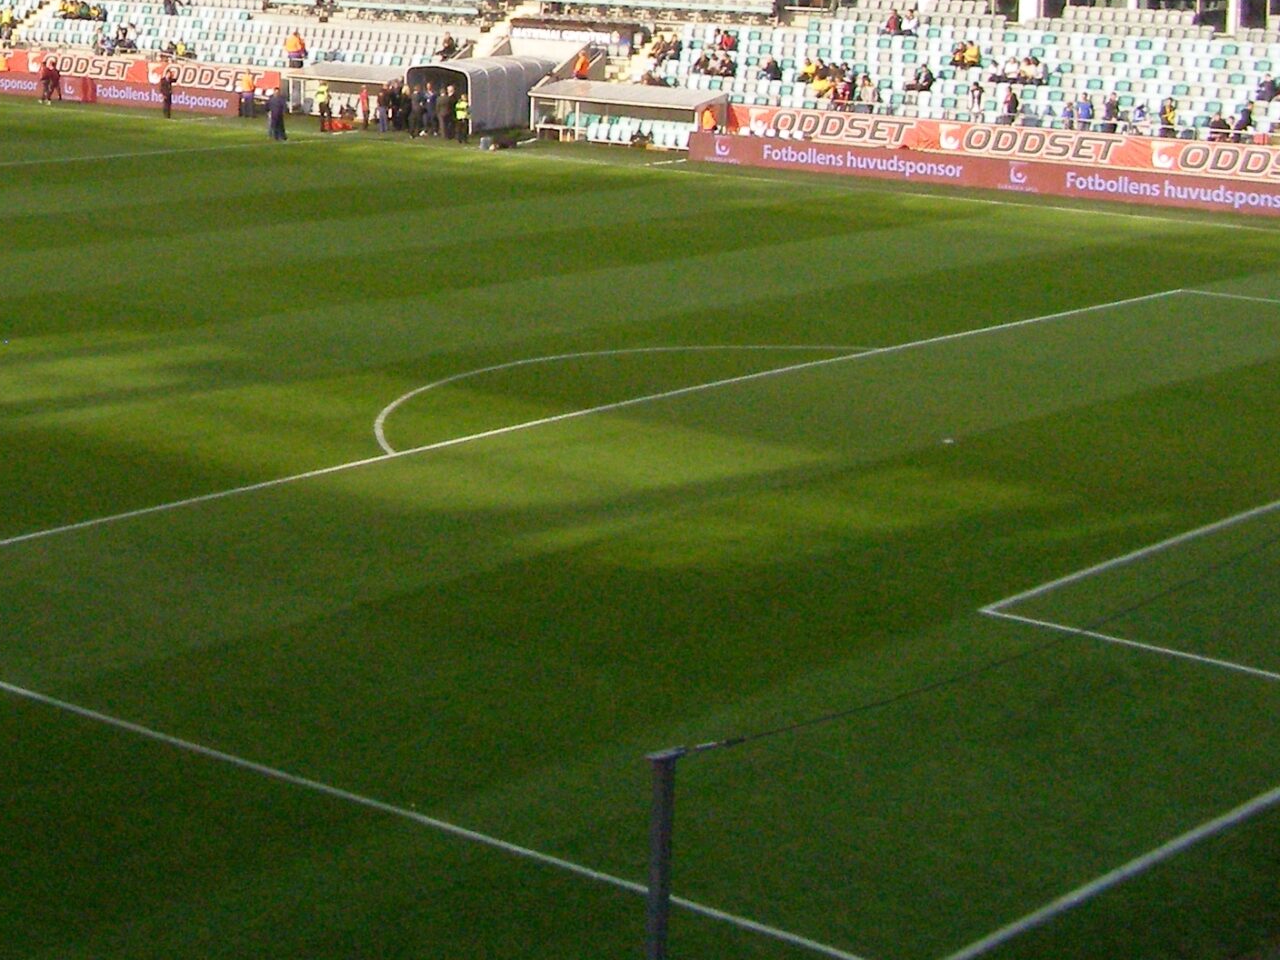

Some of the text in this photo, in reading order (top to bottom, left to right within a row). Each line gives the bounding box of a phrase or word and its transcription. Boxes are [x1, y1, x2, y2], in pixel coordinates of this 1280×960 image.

[96, 84, 229, 108] Fotbollens huudsponsor
[773, 112, 914, 143] ODDSET
[763, 144, 963, 177] Fotbollens huvudsponsor
[966, 128, 1122, 162] ODDSET
[1066, 171, 1160, 197] Fotbollens
